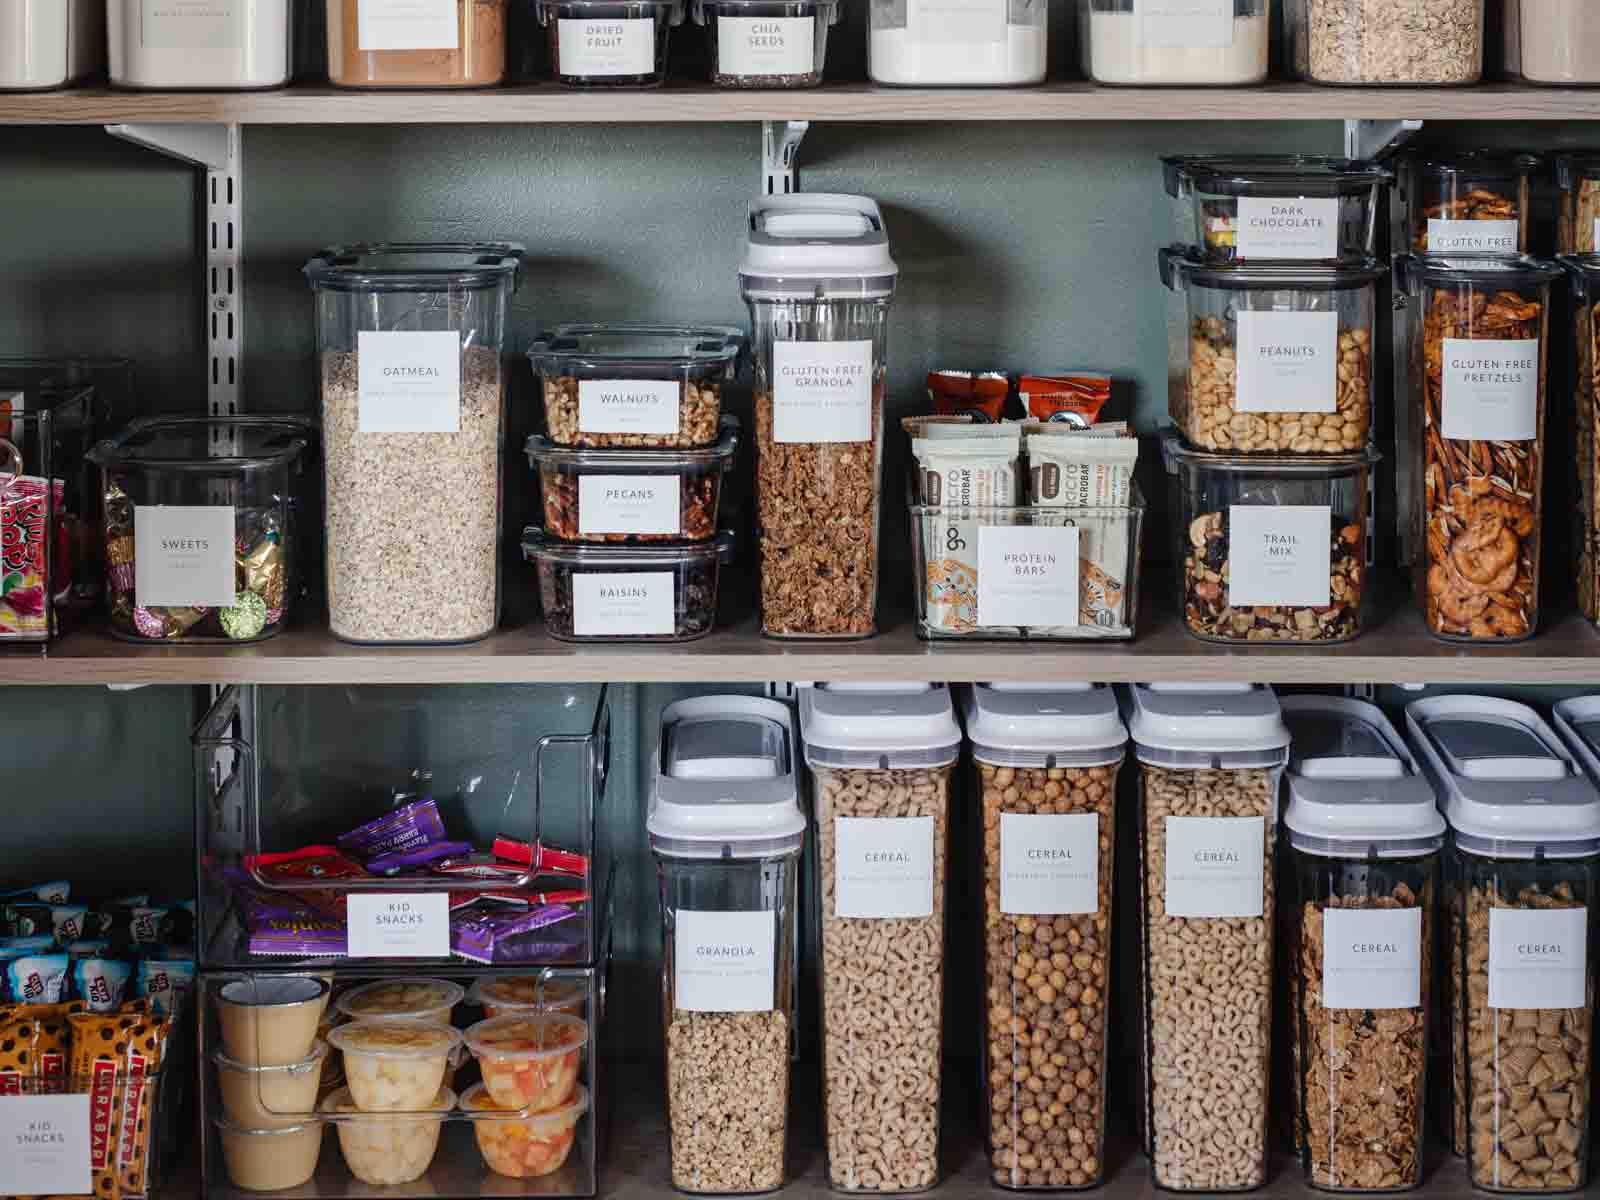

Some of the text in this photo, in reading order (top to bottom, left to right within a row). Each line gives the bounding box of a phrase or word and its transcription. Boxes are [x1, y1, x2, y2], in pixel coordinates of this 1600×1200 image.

[585, 25, 624, 36] DRIED
[751, 24, 782, 35] CHIA
[586, 37, 623, 48] FRUIT
[749, 36, 785, 47] SEEDS
[1271, 206, 1305, 216] DARK
[1250, 217, 1323, 228] CHOCOLATE
[1437, 237, 1513, 248] GLUTEN FREE
[1259, 346, 1315, 357] PEANUTS
[1451, 359, 1533, 369] GLUTEN FREE
[383, 367, 440, 377] OATMEAL
[782, 366, 864, 376] GLUTEN FREE
[795, 377, 854, 387] GRANOLA
[1463, 373, 1522, 383] PRETZELS
[600, 394, 658, 404] WALNUTS
[606, 489, 655, 499] PECANS
[161, 539, 209, 550] SWEETS
[1263, 534, 1298, 545] TRAIL
[1269, 546, 1292, 556] MIX
[1003, 553, 1056, 563] PROTEIN
[1015, 566, 1047, 576] BARS
[600, 587, 648, 598] RAISINS
[864, 852, 911, 863] CEREAL
[1027, 849, 1073, 860] CEREAL
[1194, 851, 1240, 862] CEREAL
[388, 902, 411, 914] KID
[375, 914, 424, 925] SNACKS
[695, 945, 755, 957] GRANOLA
[1352, 943, 1398, 953] CEREAL
[1517, 944, 1562, 954] CEREAL
[29, 1121, 51, 1131] KID
[16, 1133, 65, 1144] SNACKS
